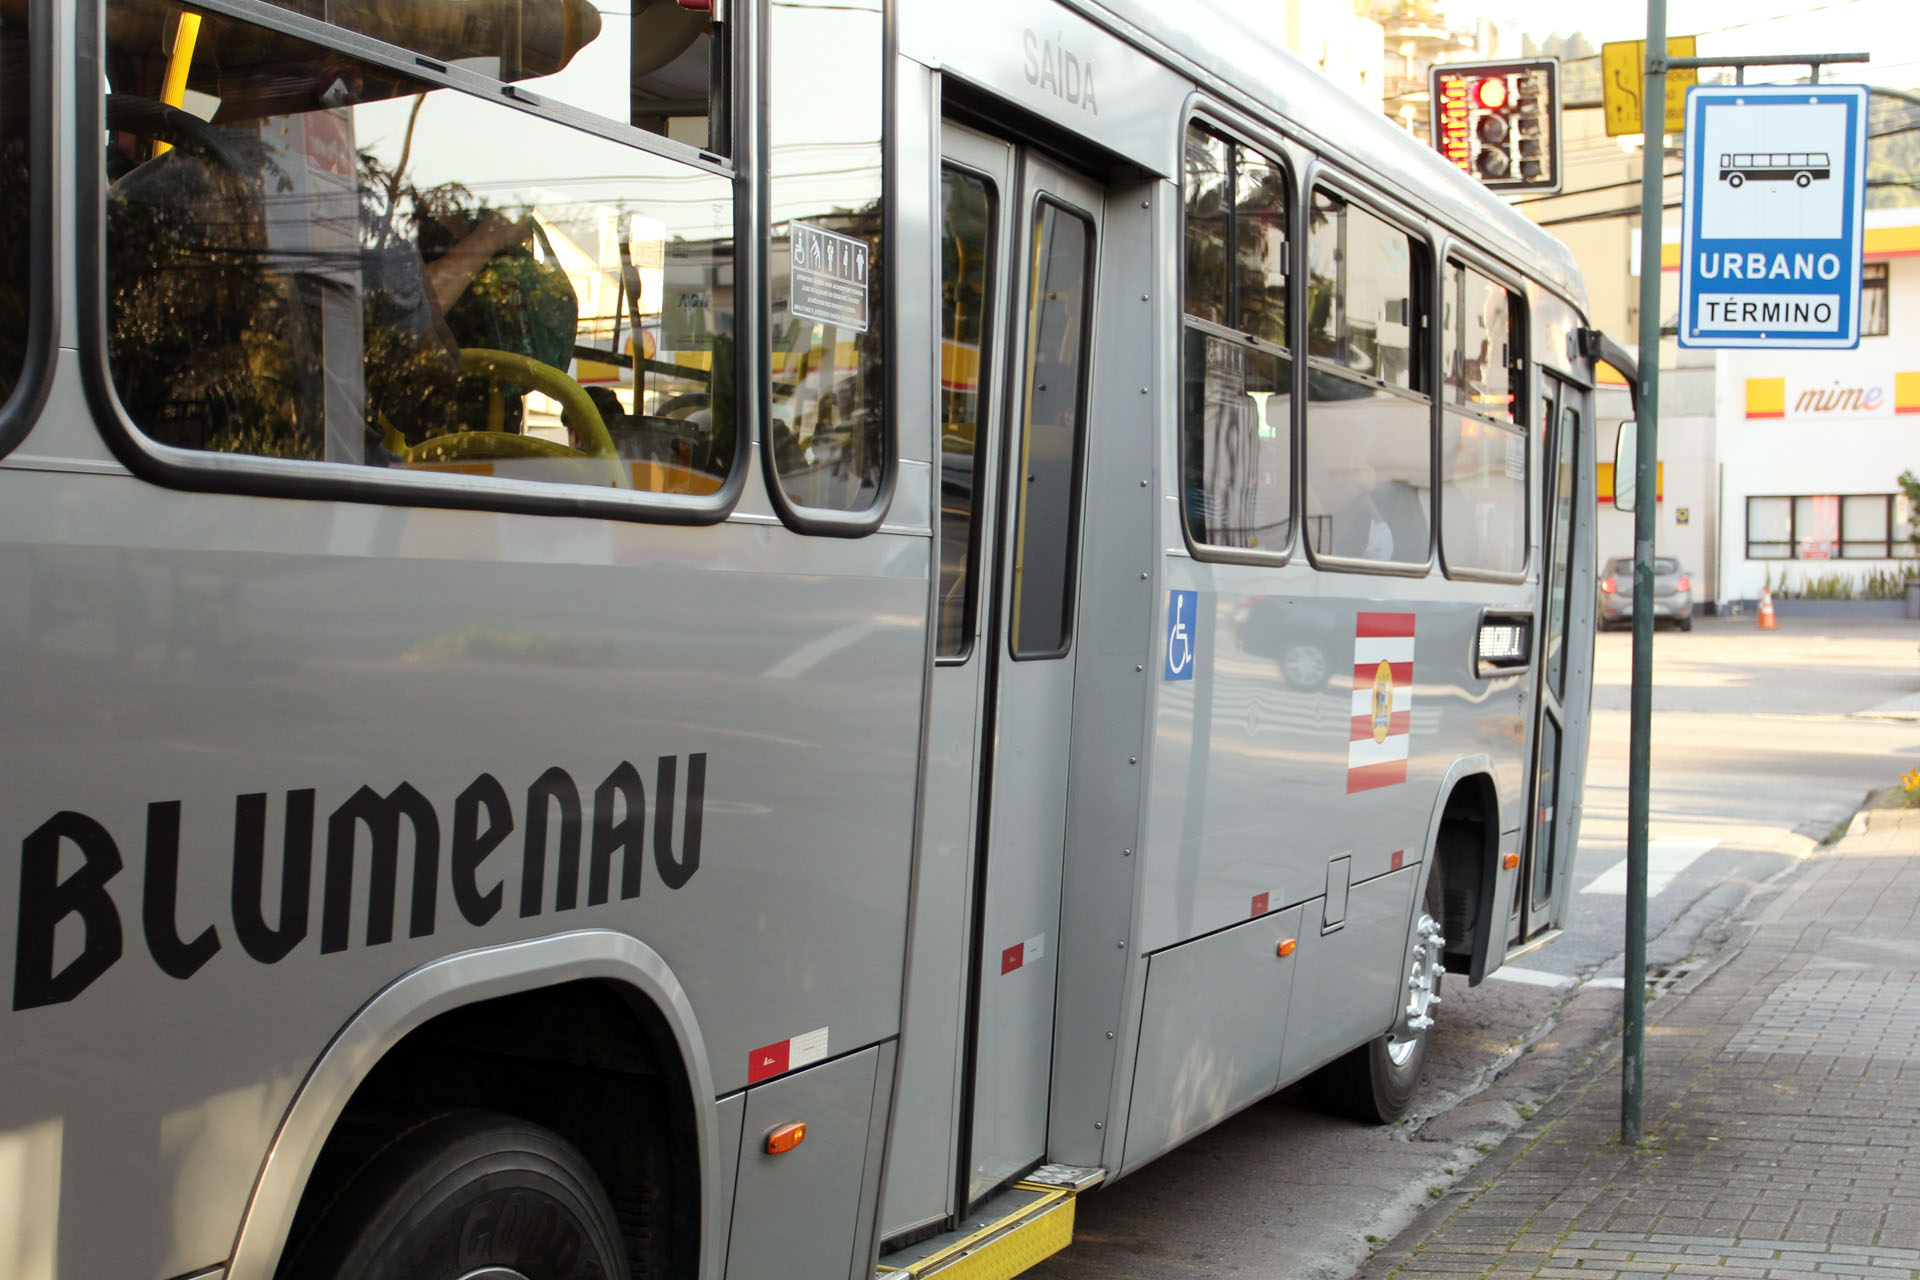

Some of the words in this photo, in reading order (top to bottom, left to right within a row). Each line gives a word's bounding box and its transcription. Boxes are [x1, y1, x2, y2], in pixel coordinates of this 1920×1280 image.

[1023, 27, 1098, 116] SAÍDA
[1700, 252, 1841, 280] URBANO
[1706, 296, 1832, 323] TÉRMINO
[1794, 379, 1885, 412] mime
